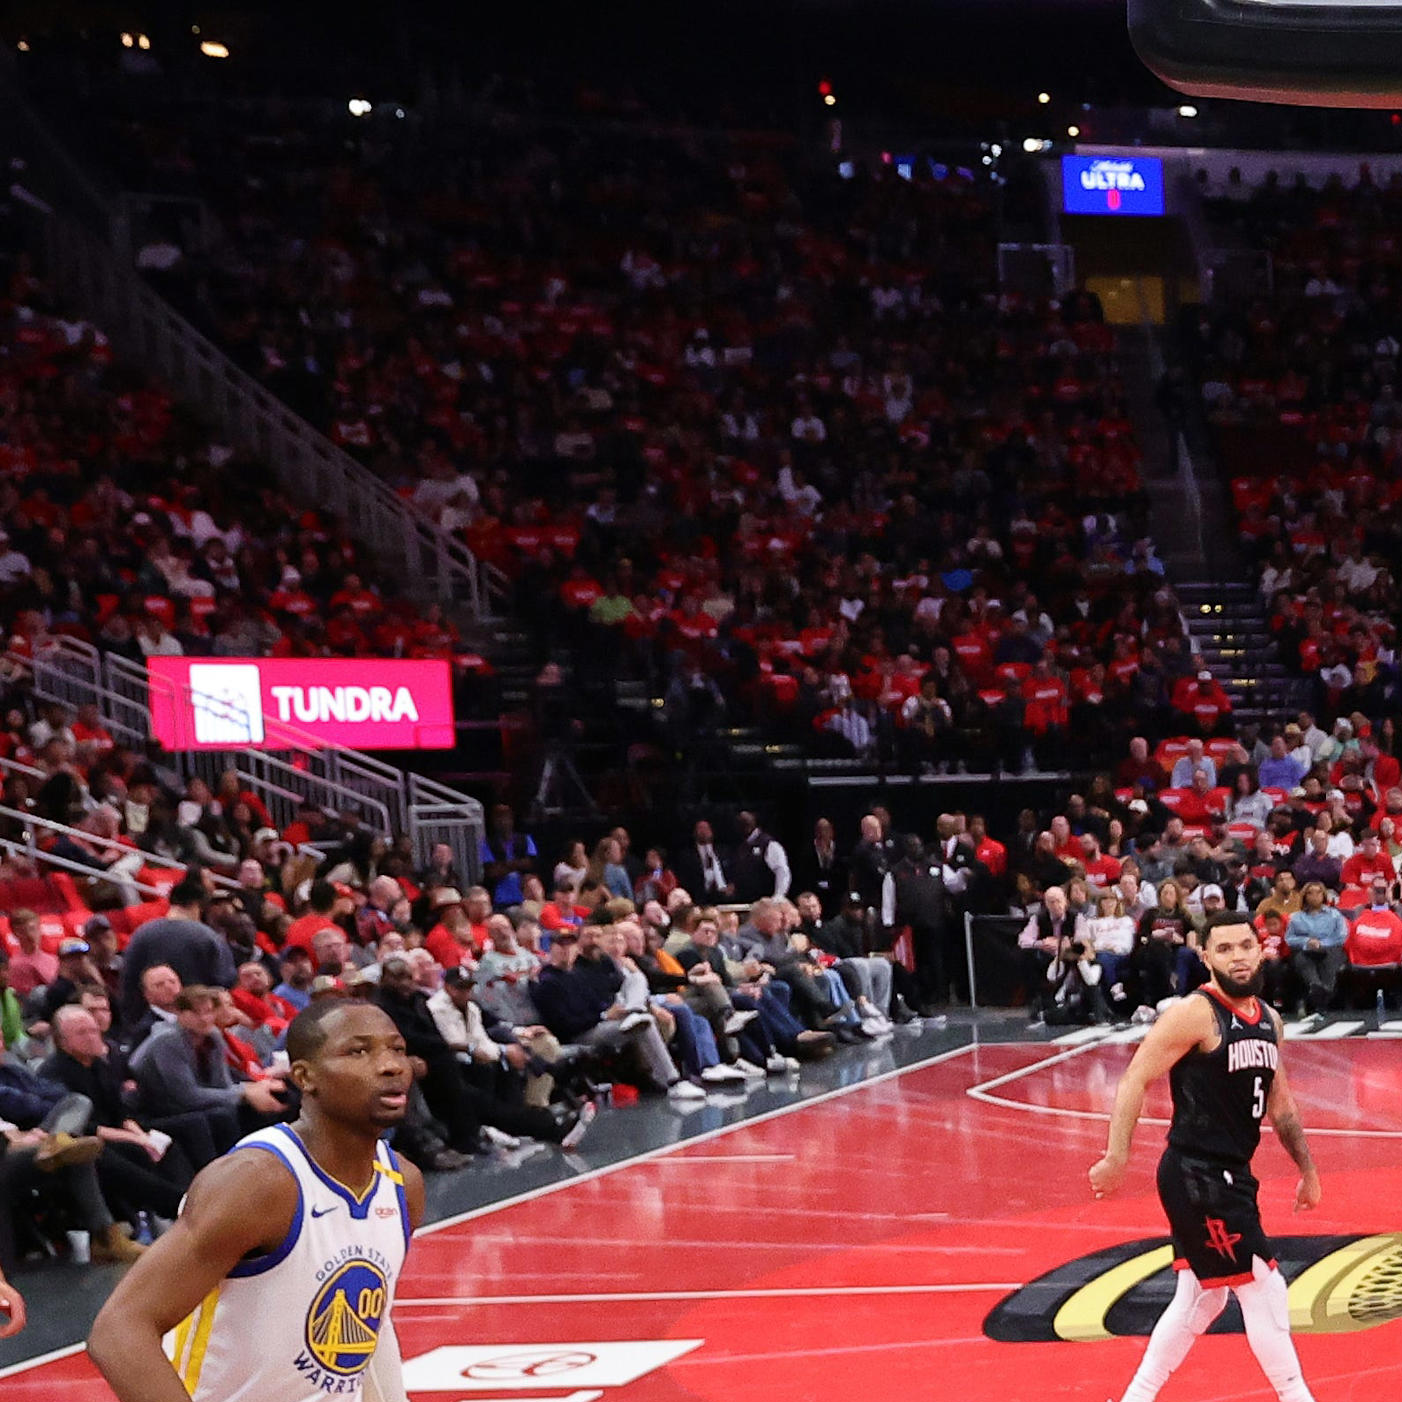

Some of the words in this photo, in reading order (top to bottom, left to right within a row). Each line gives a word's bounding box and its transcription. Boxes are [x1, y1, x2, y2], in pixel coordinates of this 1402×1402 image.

[1081, 171, 1146, 191] ULTRA
[271, 686, 419, 722] TUNDRA
[1227, 1038, 1278, 1073] HOUSTO
[1251, 1076, 1265, 1119] 5
[315, 1245, 363, 1283] GOLDEN
[357, 1287, 383, 1320] 00
